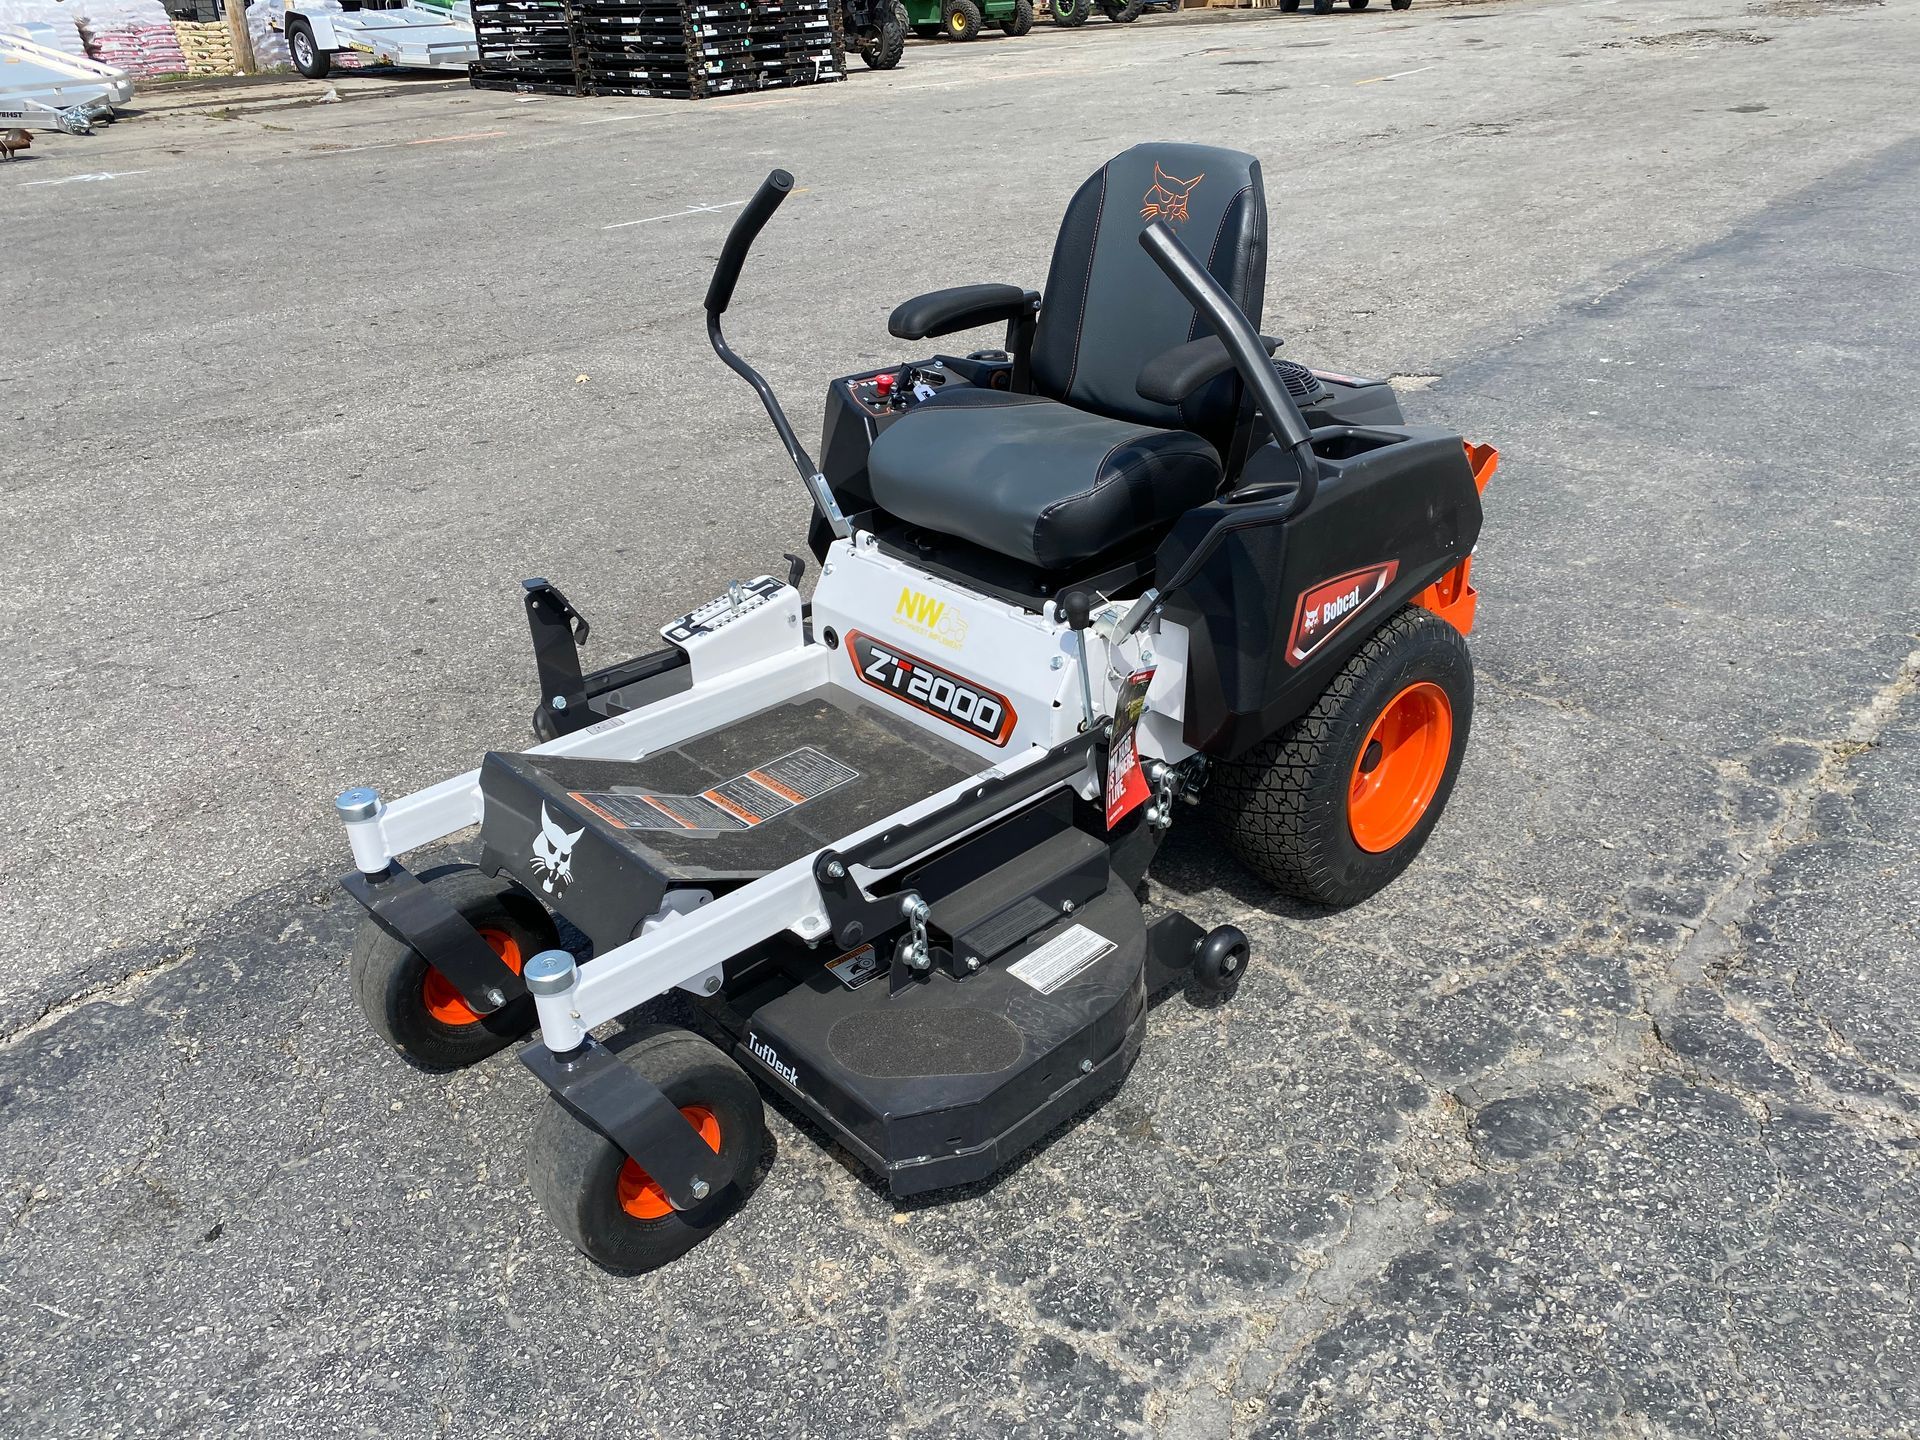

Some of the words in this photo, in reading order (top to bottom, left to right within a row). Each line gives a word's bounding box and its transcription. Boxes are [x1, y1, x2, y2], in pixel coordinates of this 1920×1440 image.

[896, 586, 945, 628] NW
[1323, 585, 1360, 625] Bobcat
[865, 647, 1002, 733] ZT2000
[748, 1031, 799, 1086] TufDeck
